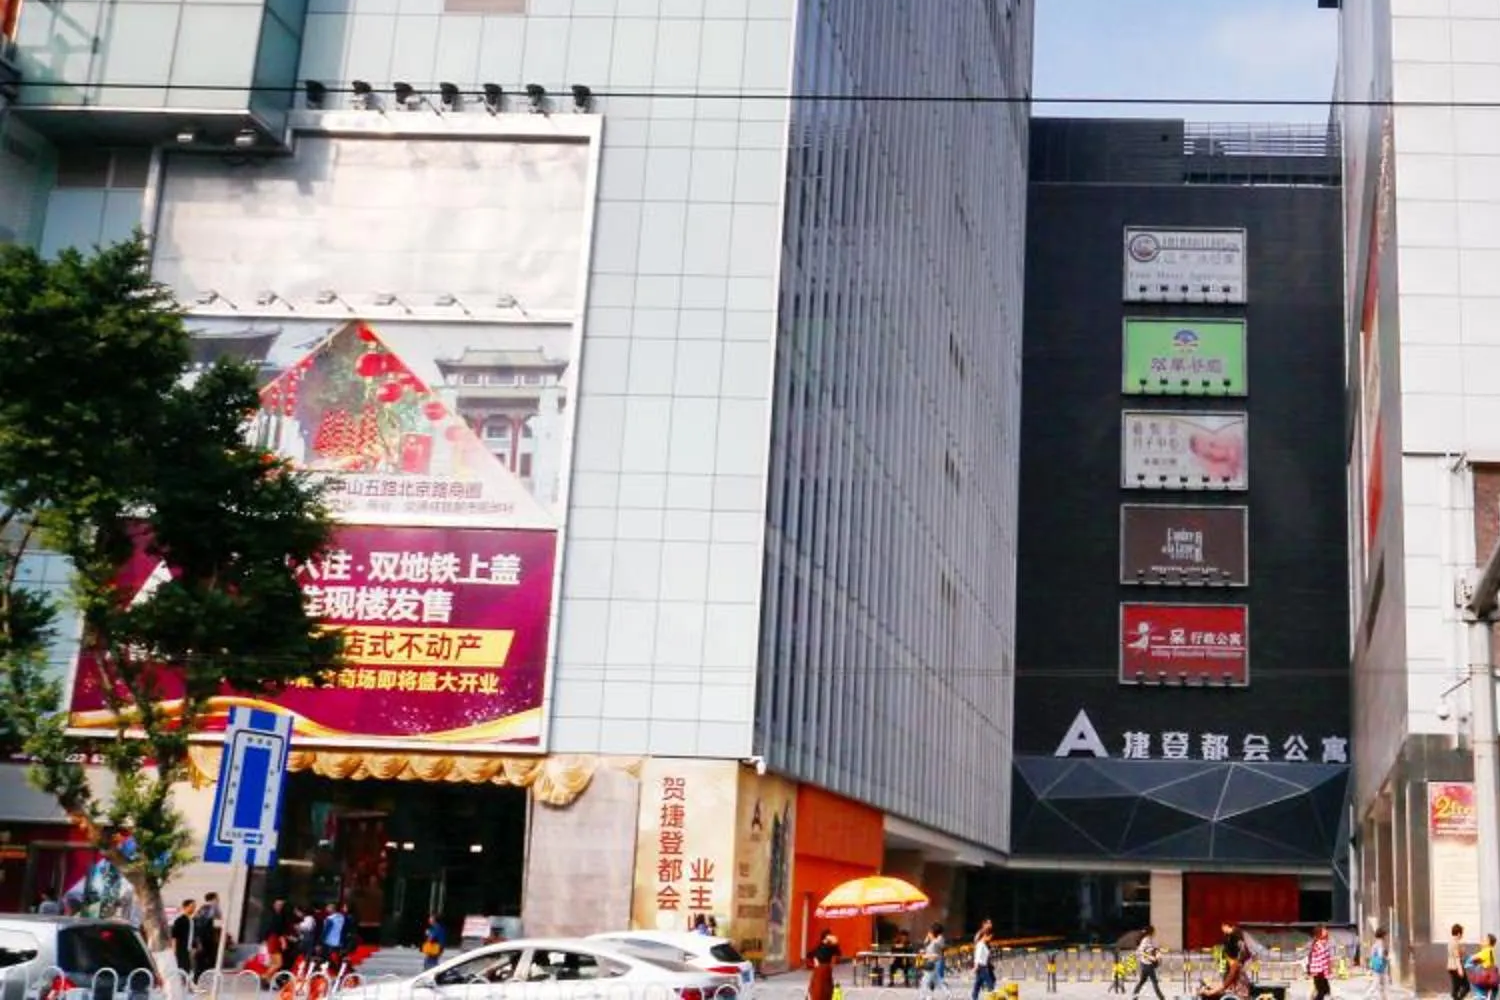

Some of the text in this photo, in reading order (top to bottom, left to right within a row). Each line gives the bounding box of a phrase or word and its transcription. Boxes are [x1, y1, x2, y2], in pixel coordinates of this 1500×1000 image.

[1122, 730, 1349, 763] 捷登都会公寓
[656, 776, 686, 912] 贺捷登都会
